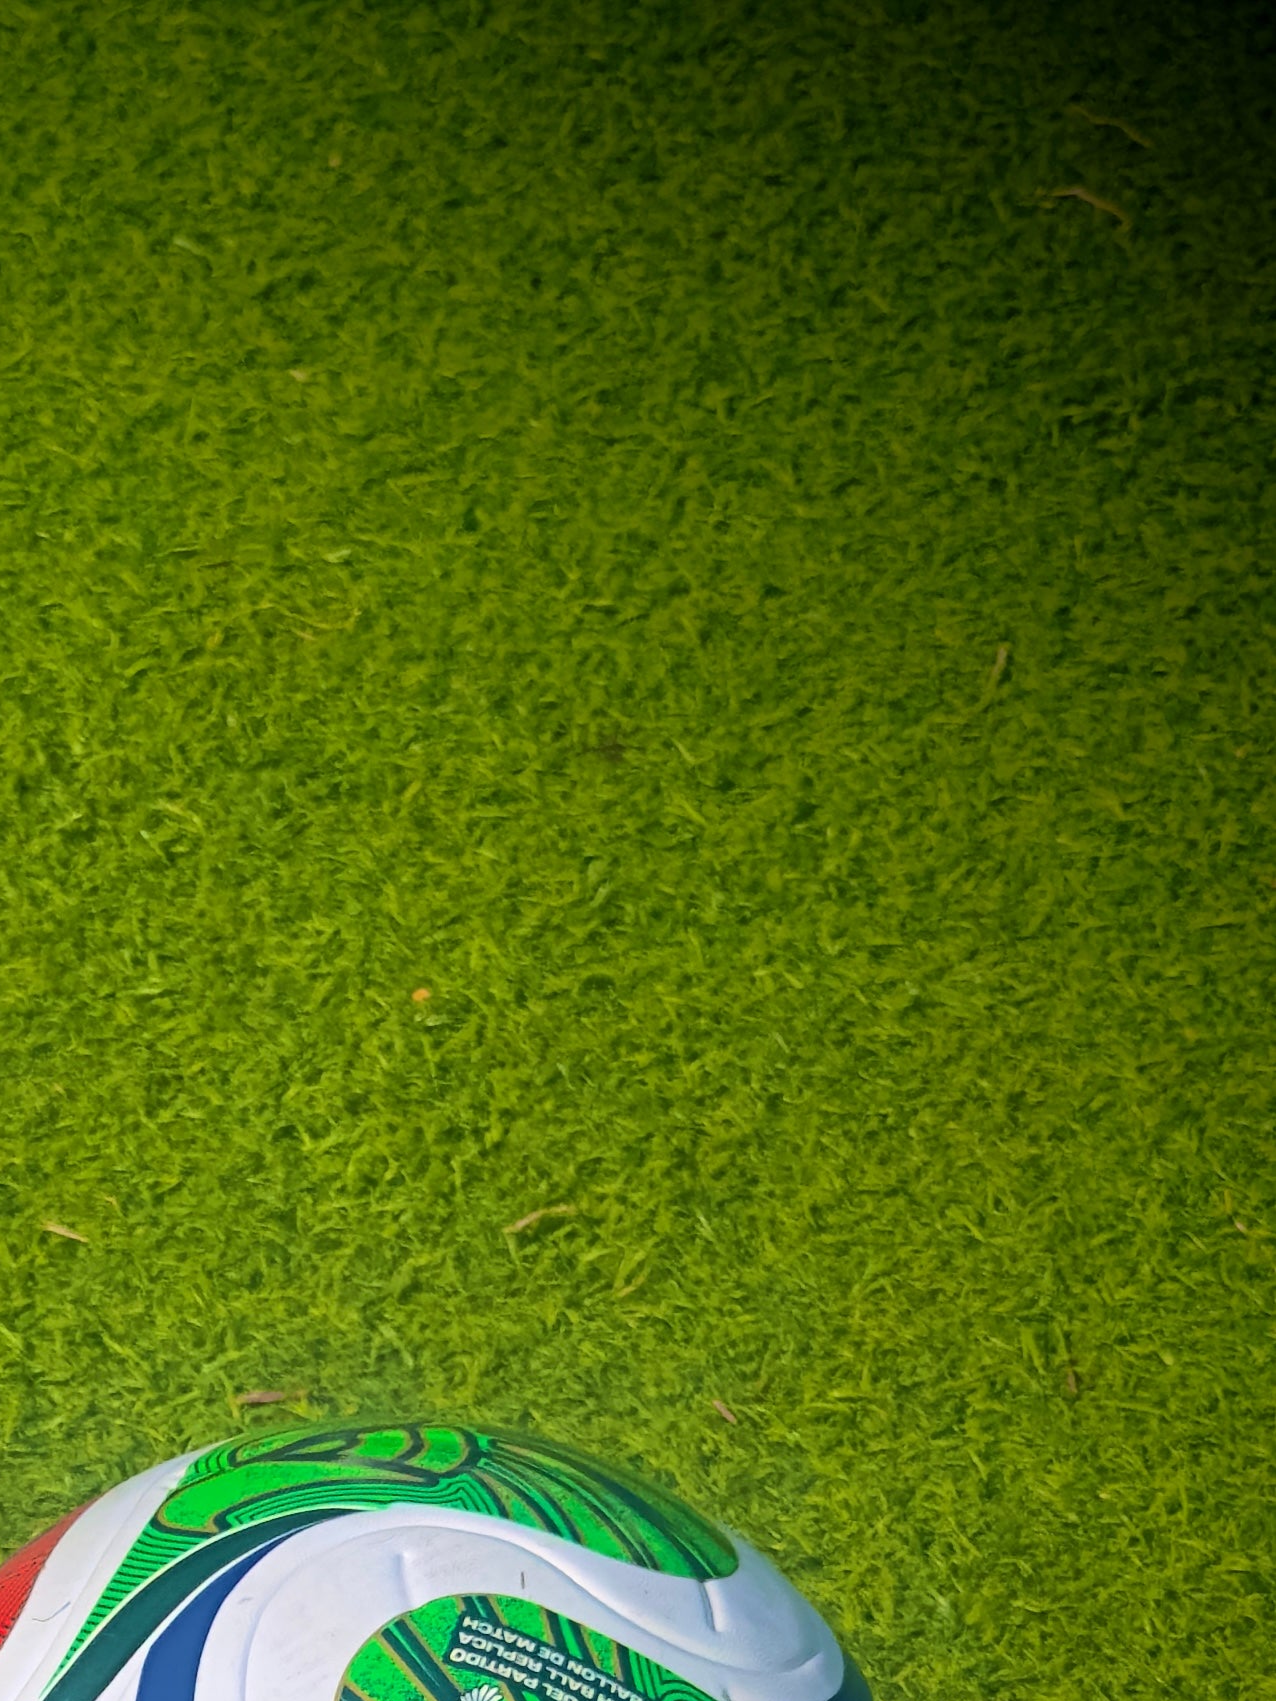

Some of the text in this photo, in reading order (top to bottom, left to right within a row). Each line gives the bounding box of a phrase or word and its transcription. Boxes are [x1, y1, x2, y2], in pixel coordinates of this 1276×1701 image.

[458, 1631, 543, 1672] REPLICA
[462, 1616, 535, 1652] MATCH
[449, 1647, 539, 1690] PARTIDO
[539, 1646, 565, 1667] DE
[546, 1663, 594, 1700] BALL
